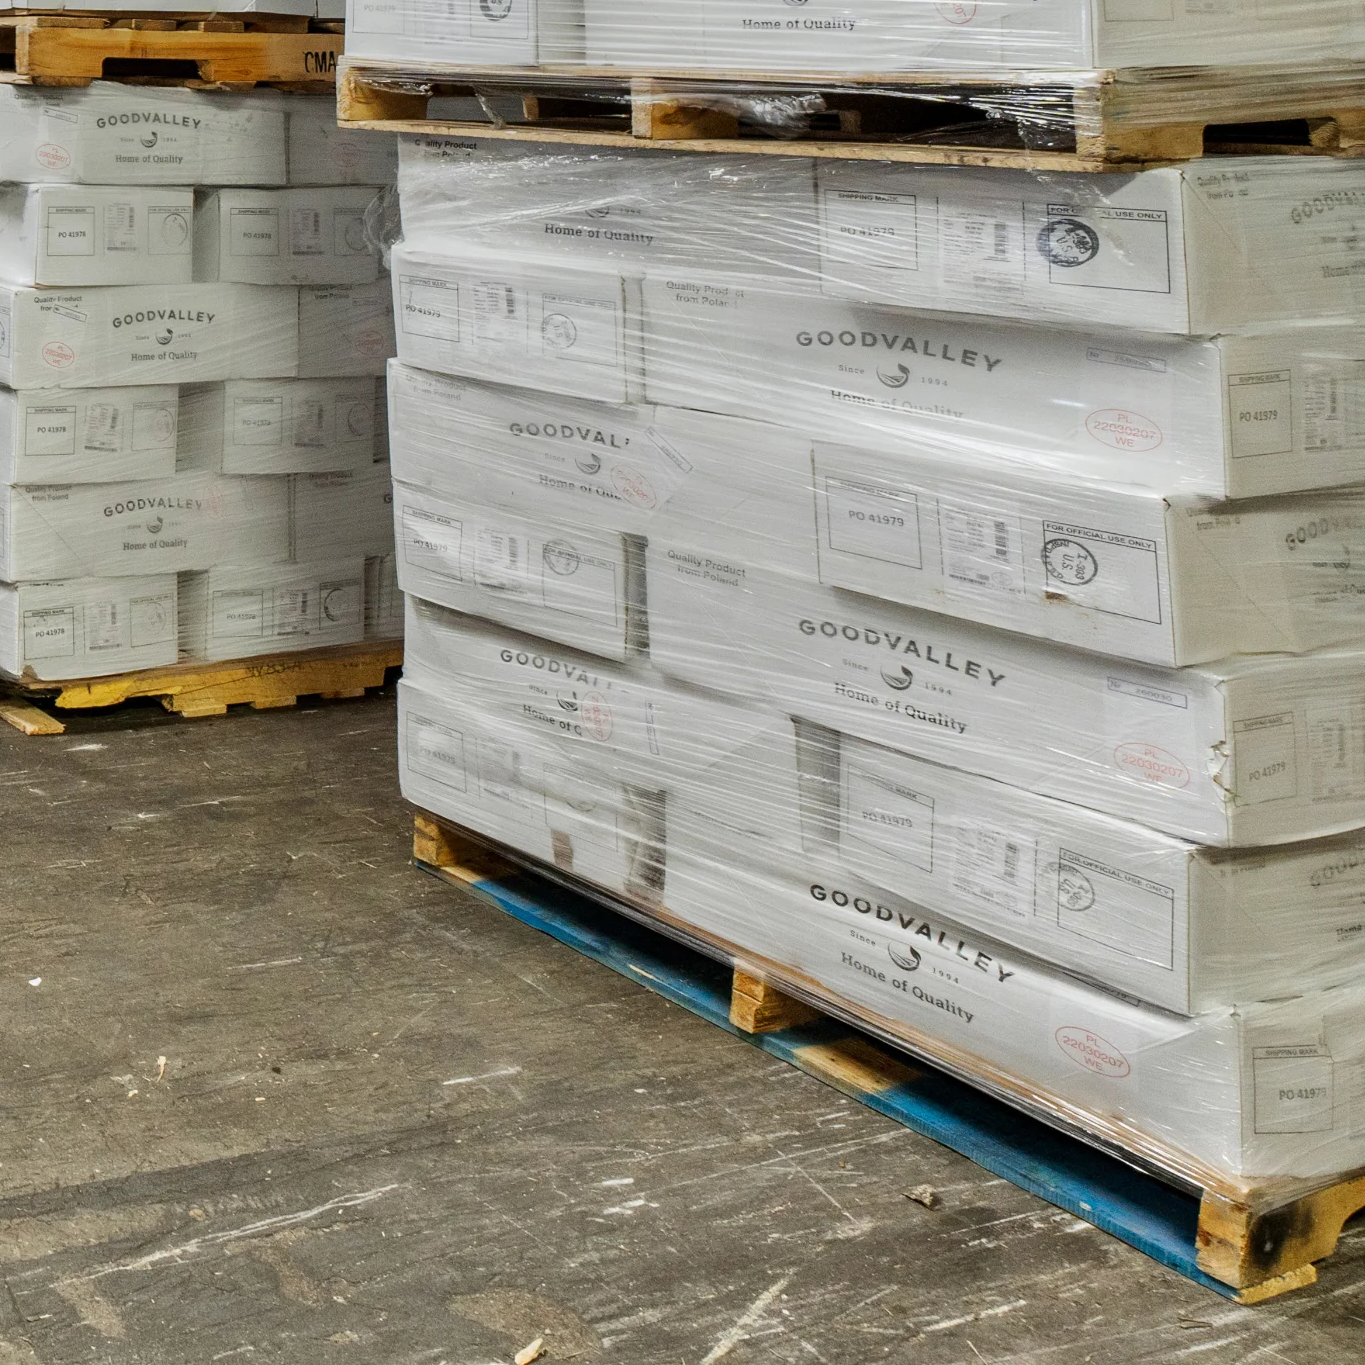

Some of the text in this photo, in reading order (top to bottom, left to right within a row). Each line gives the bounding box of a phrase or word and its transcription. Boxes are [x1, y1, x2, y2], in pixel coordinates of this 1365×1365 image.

[742, 17, 856, 31] Home of Quality
[96, 113, 201, 129] GOODVALLEY
[445, 141, 477, 150] Product
[116, 155, 183, 165] Home of Quality
[545, 223, 654, 245] Home of Quality
[666, 281, 700, 293] Quality
[676, 294, 699, 303] from
[112, 310, 215, 328] GOODVALLEY
[131, 353, 156, 361] Home
[169, 351, 197, 361] Quality
[796, 330, 1003, 373] GOODVALLEY
[838, 365, 948, 387] Since 1994
[831, 390, 963, 418] Home of Quality
[1118, 414, 1131, 423] PL
[1239, 410, 1277, 421] PO 41979
[1094, 422, 1156, 441] 22030207
[1115, 438, 1134, 447] WE
[539, 474, 575, 492] Home
[104, 498, 203, 517] GOODVALLEY
[848, 511, 905, 528] PO 41979
[123, 539, 188, 550] Home of Quality
[1046, 523, 1063, 531] FOR
[1066, 528, 1106, 540] OFFICIAL
[1129, 540, 1152, 548] ONLY
[667, 550, 746, 577] Quality Product
[46, 628, 65, 637] 41978
[799, 619, 1007, 687] GOODVALLEY
[842, 658, 952, 695] Since 1994
[524, 704, 571, 730] Home of
[834, 683, 966, 733] Home of Quality
[1145, 748, 1158, 758] PL
[1121, 752, 1183, 777] 22030207
[1249, 762, 1286, 782] PO 41979
[893, 788, 918, 799] MARK
[1124, 876, 1143, 885] USE
[809, 884, 1015, 983] GOODVALLEY
[850, 930, 959, 983] Since 1994
[841, 952, 974, 1023] Home of Quality
[1085, 1035, 1101, 1045] PL
[1062, 1036, 1124, 1068] 22030207
[1084, 1056, 1103, 1070] WE
[1279, 1090, 1294, 1100] PO
